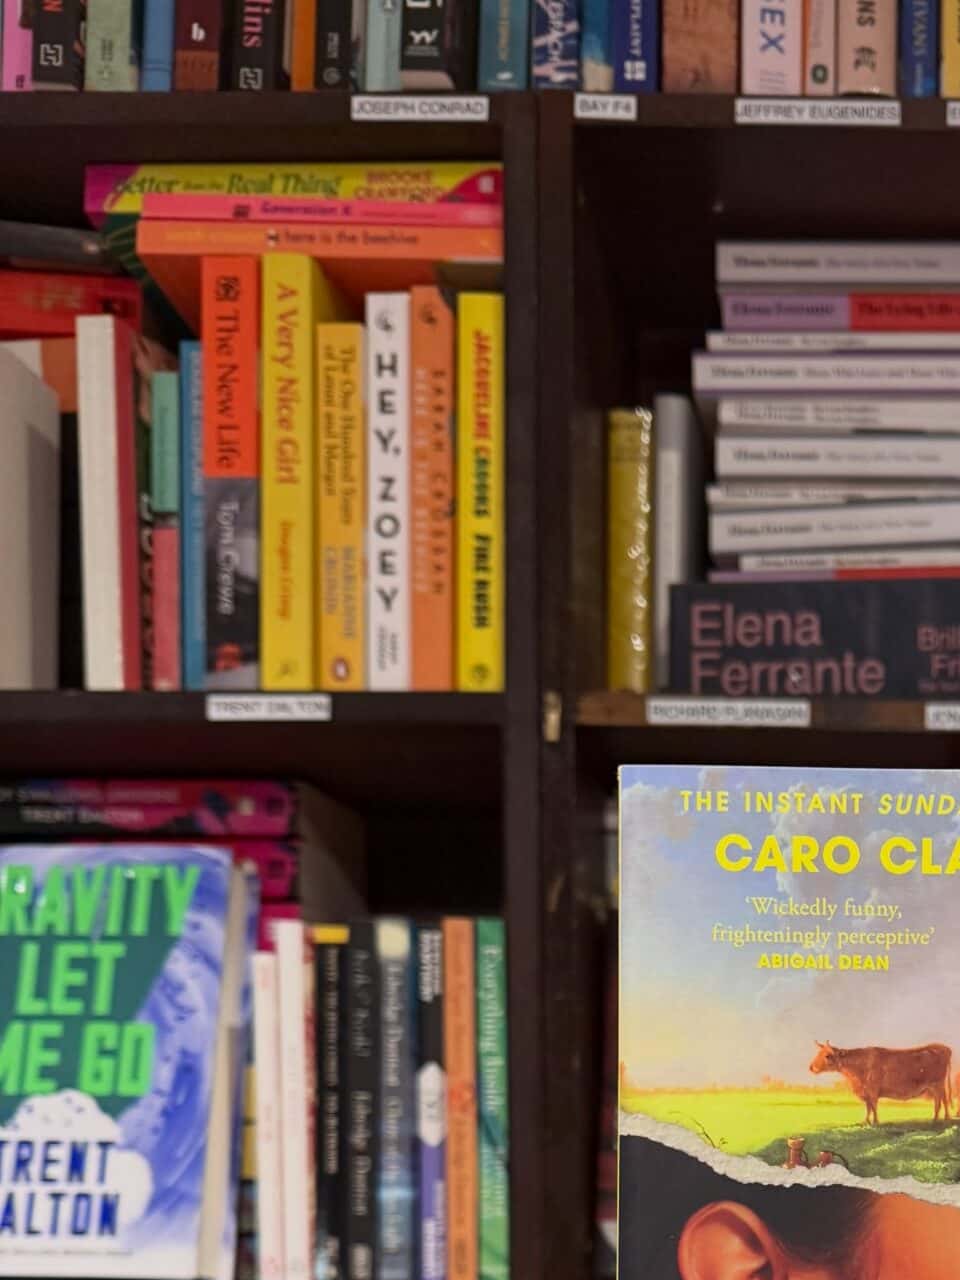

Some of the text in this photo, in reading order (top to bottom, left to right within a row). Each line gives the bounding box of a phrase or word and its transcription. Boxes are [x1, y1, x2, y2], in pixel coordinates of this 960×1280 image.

[354, 100, 485, 116] JOSEPH CONRAD
[579, 101, 633, 115] BAY F4
[736, 103, 898, 121] JEFFREY EUGENIDES
[226, 172, 274, 196] Real
[213, 312, 242, 469] The New Life
[271, 282, 299, 485] A Very Nice Girl
[214, 500, 240, 616] Tom Crewe
[375, 476, 401, 613] ZOEY
[474, 533, 492, 574] FIRE
[690, 603, 823, 648] Elena
[690, 651, 885, 697] Ferrante
[680, 791, 729, 814] THE
[744, 791, 864, 815] INSTANT
[715, 834, 861, 873] CARO
[844, 897, 903, 920] funny,
[711, 923, 831, 947] frighteningly
[15, 941, 126, 1016] LET
[757, 954, 890, 971] ABIGAIL DEAN
[480, 945, 503, 1053] Everything
[79, 1021, 157, 1097] GO
